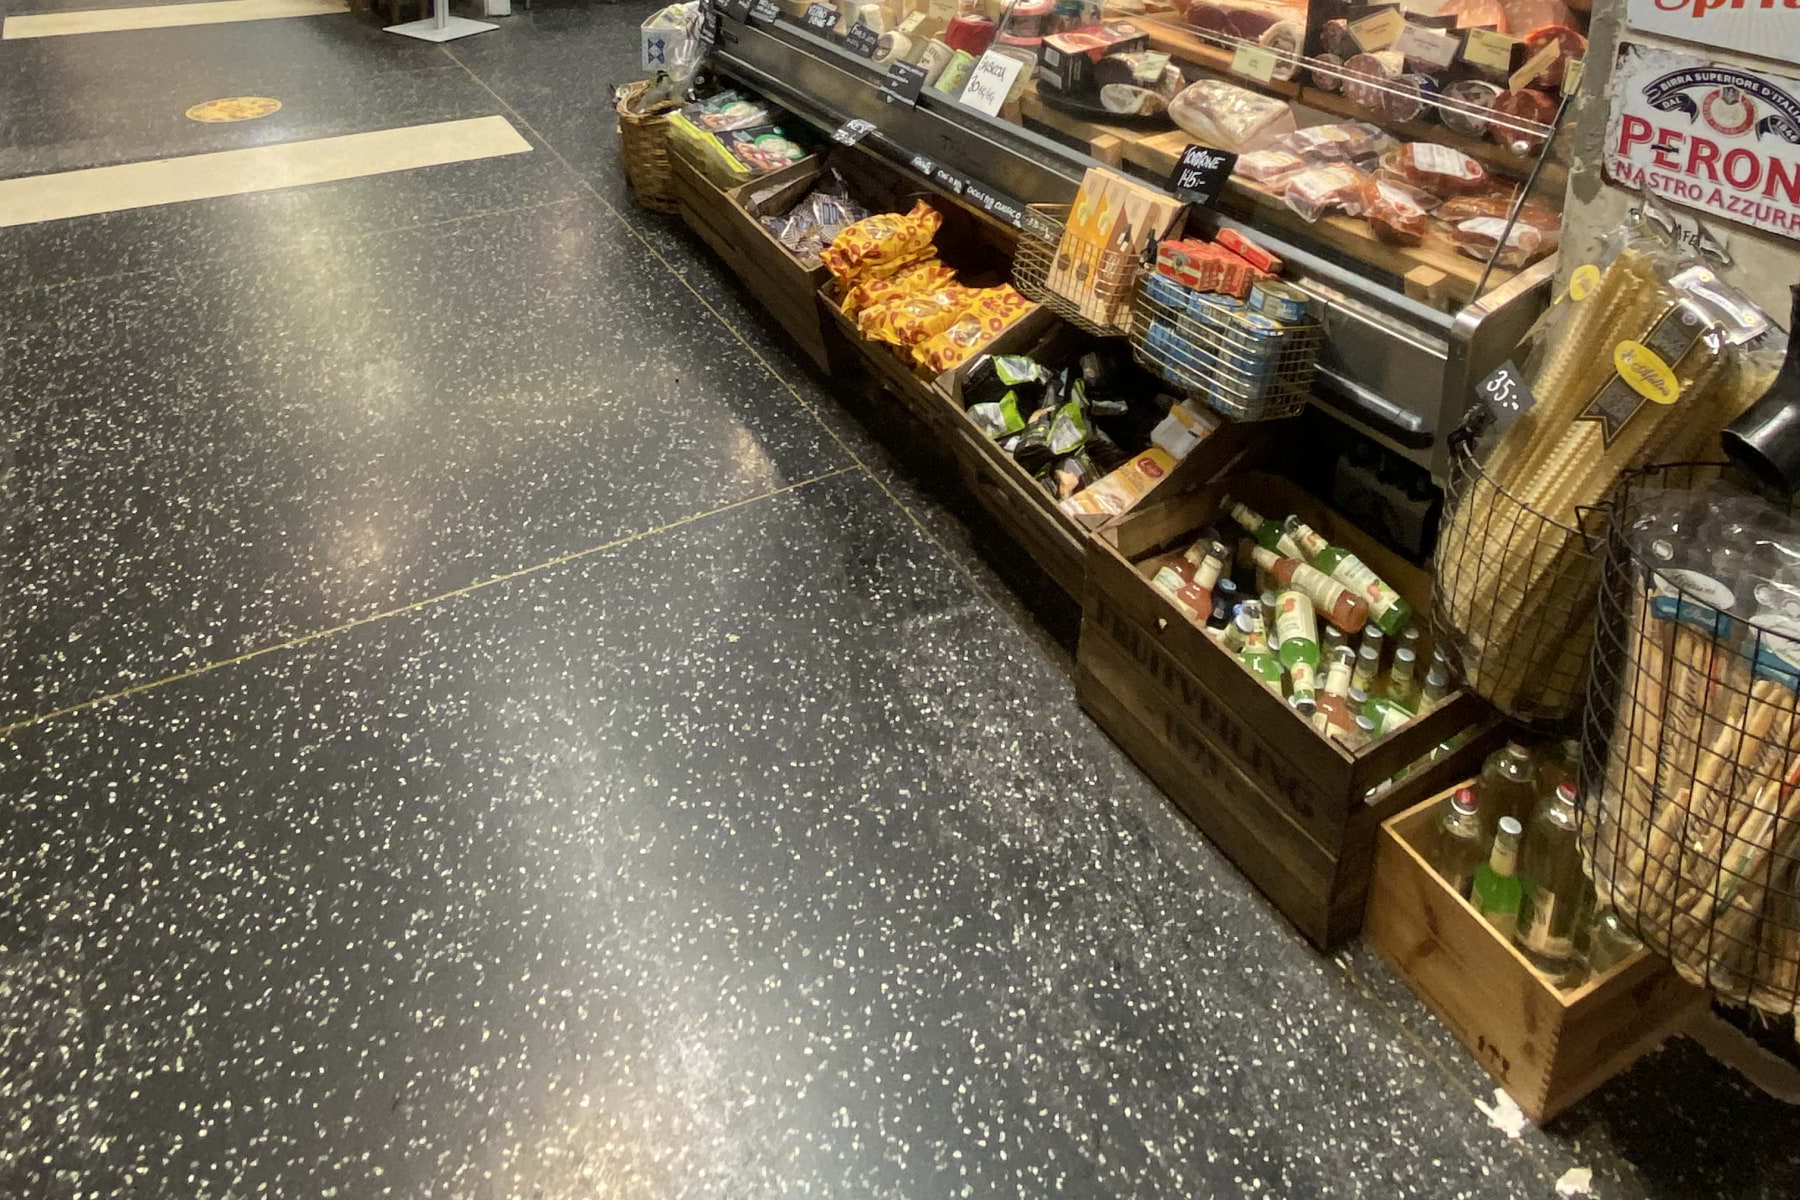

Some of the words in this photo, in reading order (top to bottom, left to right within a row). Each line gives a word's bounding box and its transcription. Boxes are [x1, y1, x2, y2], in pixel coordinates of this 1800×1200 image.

[1660, 74, 1694, 92] BIRRA
[1695, 72, 1760, 92] SUPERIORE
[1662, 97, 1681, 110] DAL
[1615, 160, 1703, 202] NASTRO
